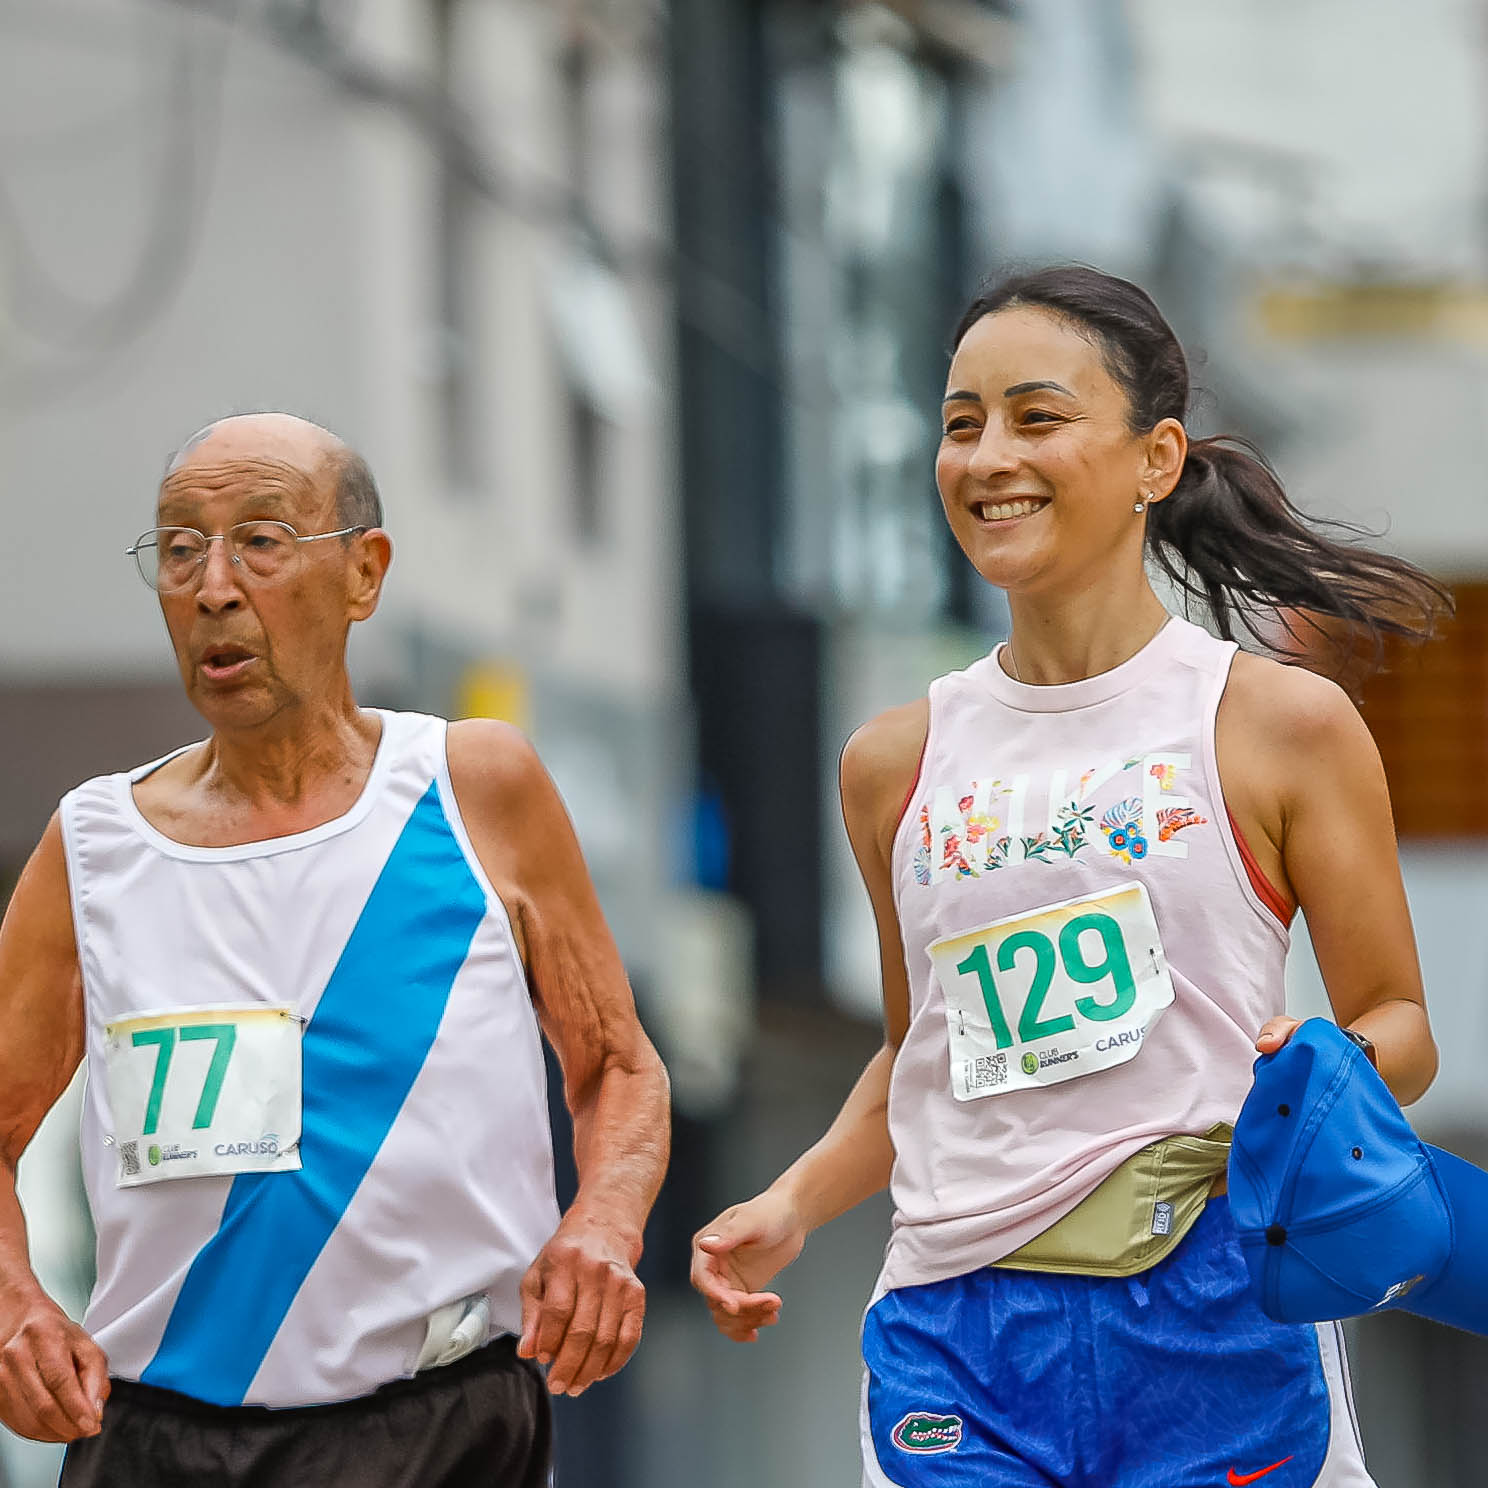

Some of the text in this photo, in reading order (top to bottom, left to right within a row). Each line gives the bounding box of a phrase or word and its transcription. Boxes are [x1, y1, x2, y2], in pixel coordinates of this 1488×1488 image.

[915, 752, 1206, 887] NIKE
[956, 912, 1138, 1050] 129
[131, 1024, 237, 1135] 77
[214, 1141, 278, 1156] CARUSO
